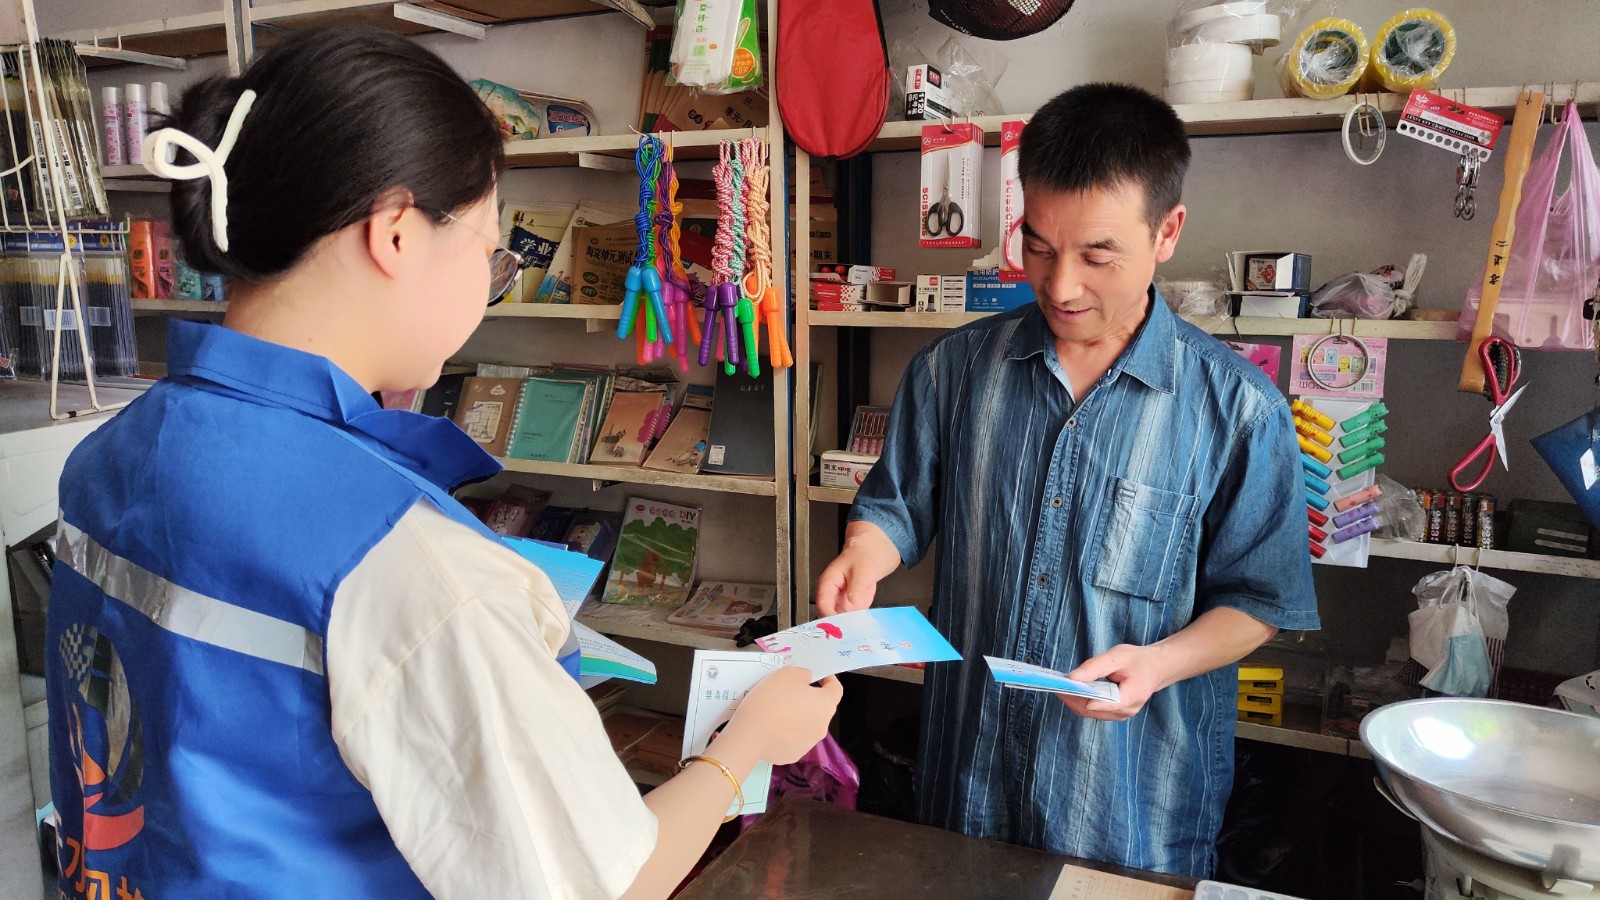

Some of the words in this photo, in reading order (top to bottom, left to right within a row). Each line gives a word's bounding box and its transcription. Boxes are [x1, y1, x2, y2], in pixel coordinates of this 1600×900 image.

[917, 92, 925, 114] 1120
[520, 237, 558, 257] 学业
[680, 510, 696, 521] DIY
